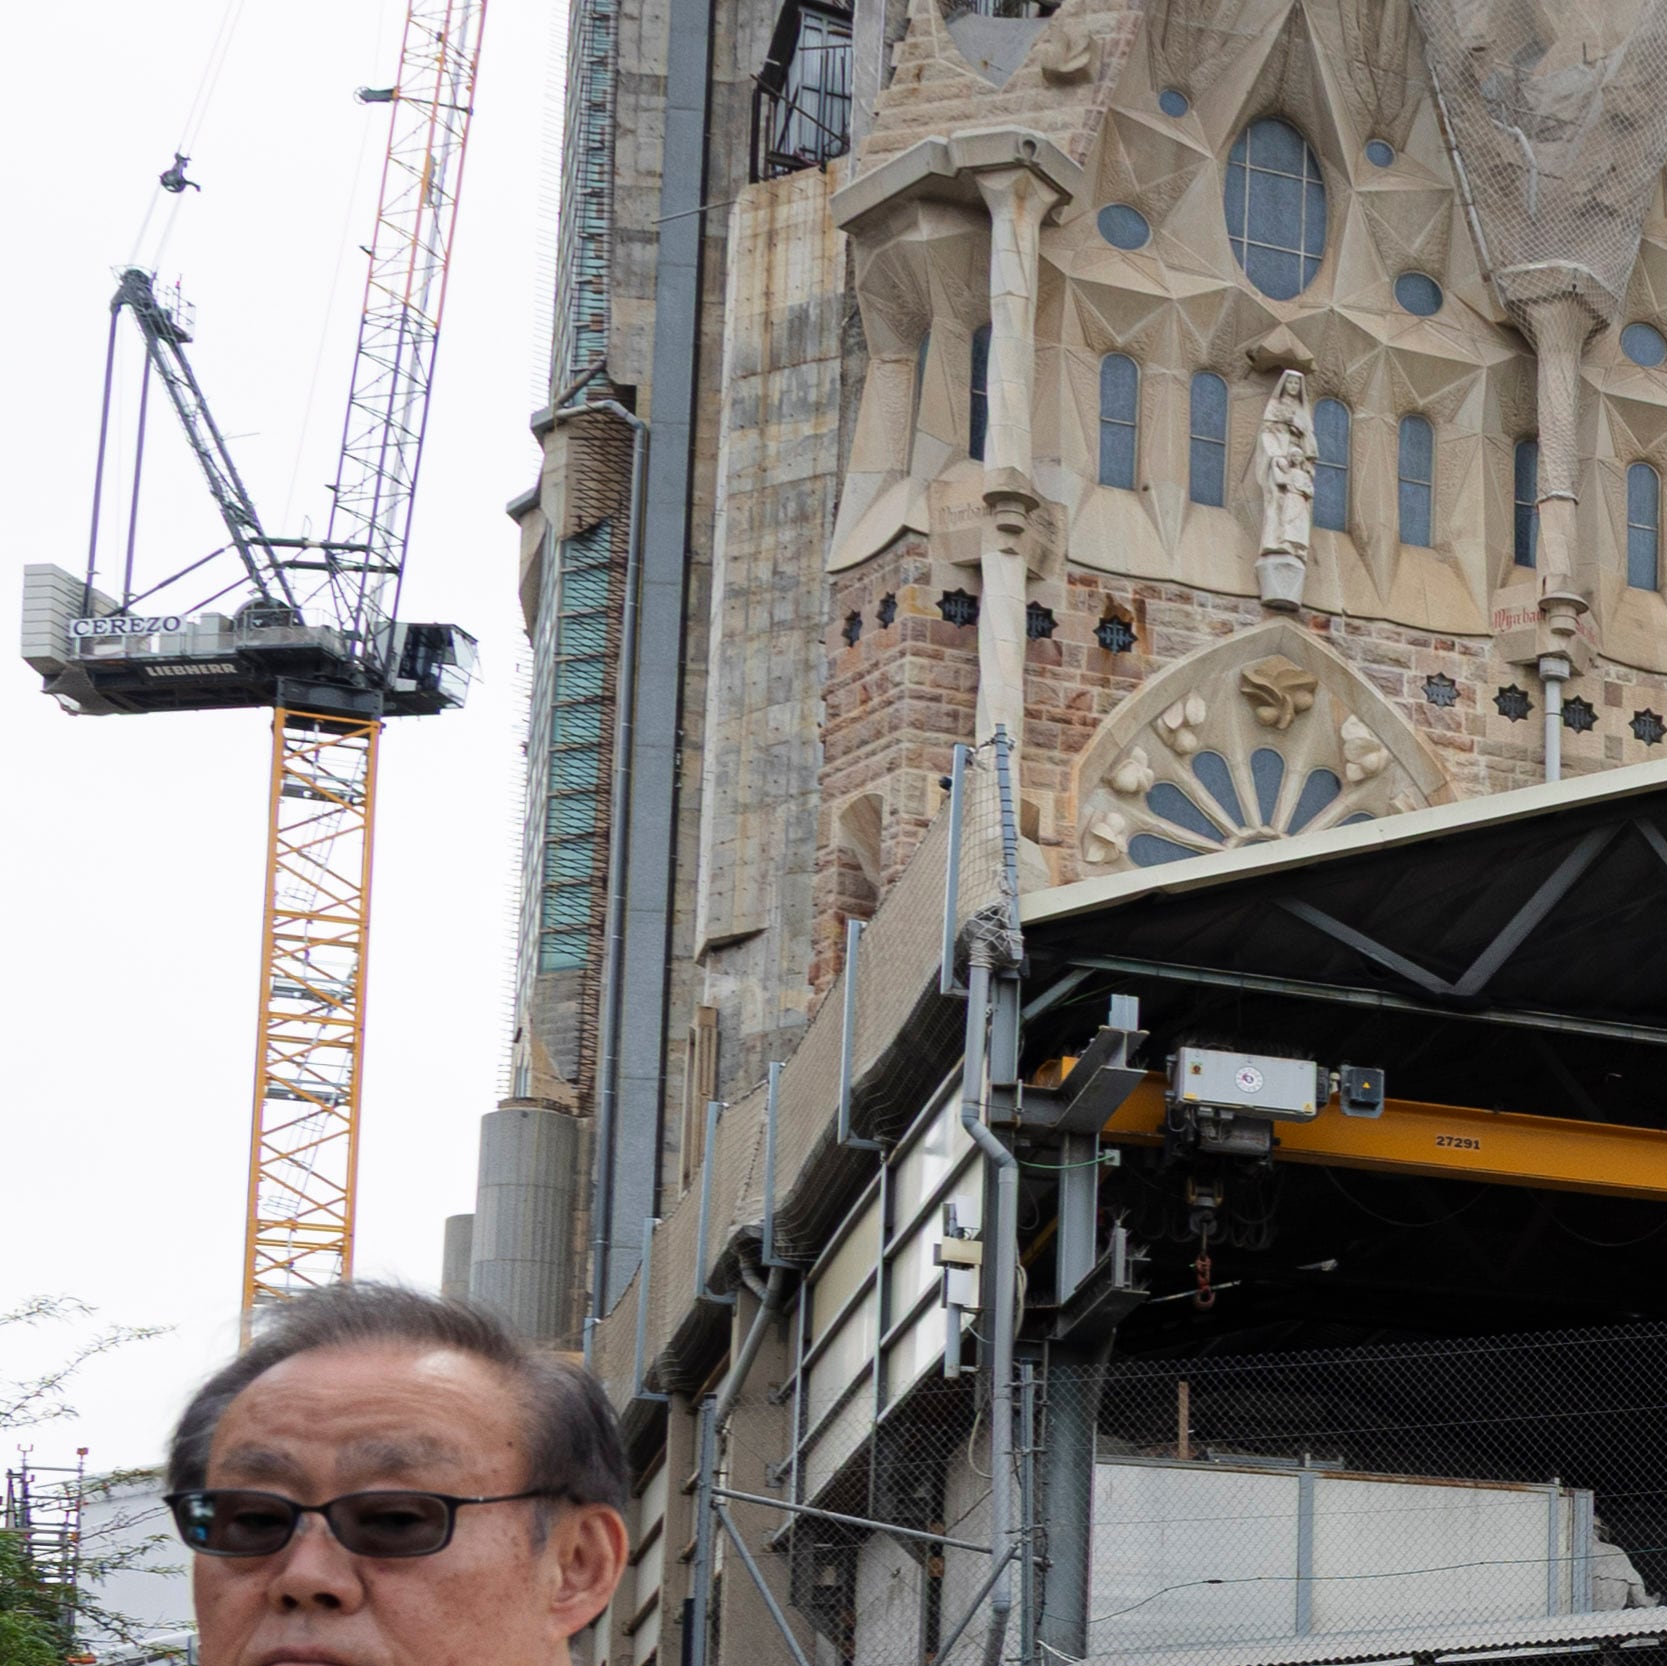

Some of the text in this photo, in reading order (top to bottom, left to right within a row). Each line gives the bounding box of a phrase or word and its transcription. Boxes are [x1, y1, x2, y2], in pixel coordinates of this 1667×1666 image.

[73, 615, 181, 637] CEREZO
[144, 662, 238, 677] LIEBHERR
[1436, 1134, 1481, 1150] 27291
